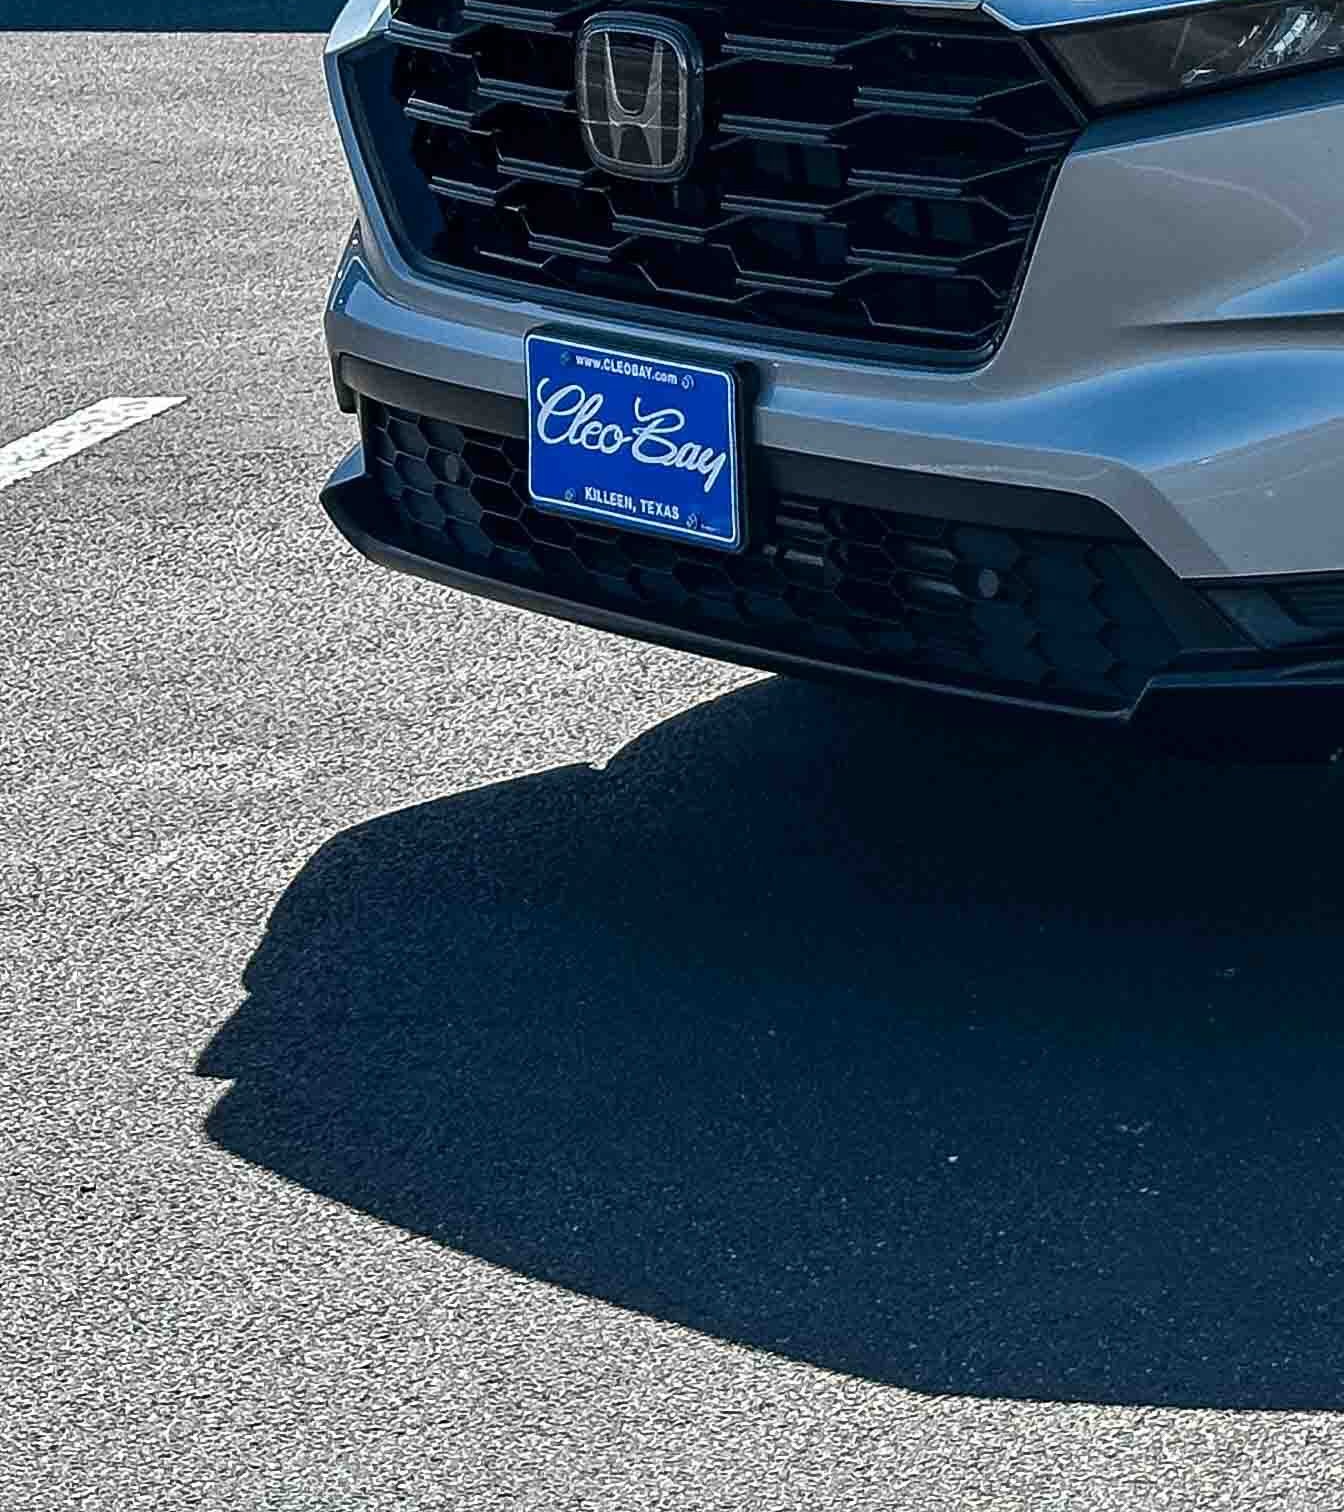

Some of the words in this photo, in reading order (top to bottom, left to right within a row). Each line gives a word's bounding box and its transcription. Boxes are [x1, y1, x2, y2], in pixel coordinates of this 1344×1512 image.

[575, 353, 678, 386] www.CLEOBAY.com
[536, 377, 632, 455] Cleo
[630, 396, 727, 494] Bay
[584, 486, 637, 514] KILLEEN,
[639, 498, 681, 522] TEXAS
